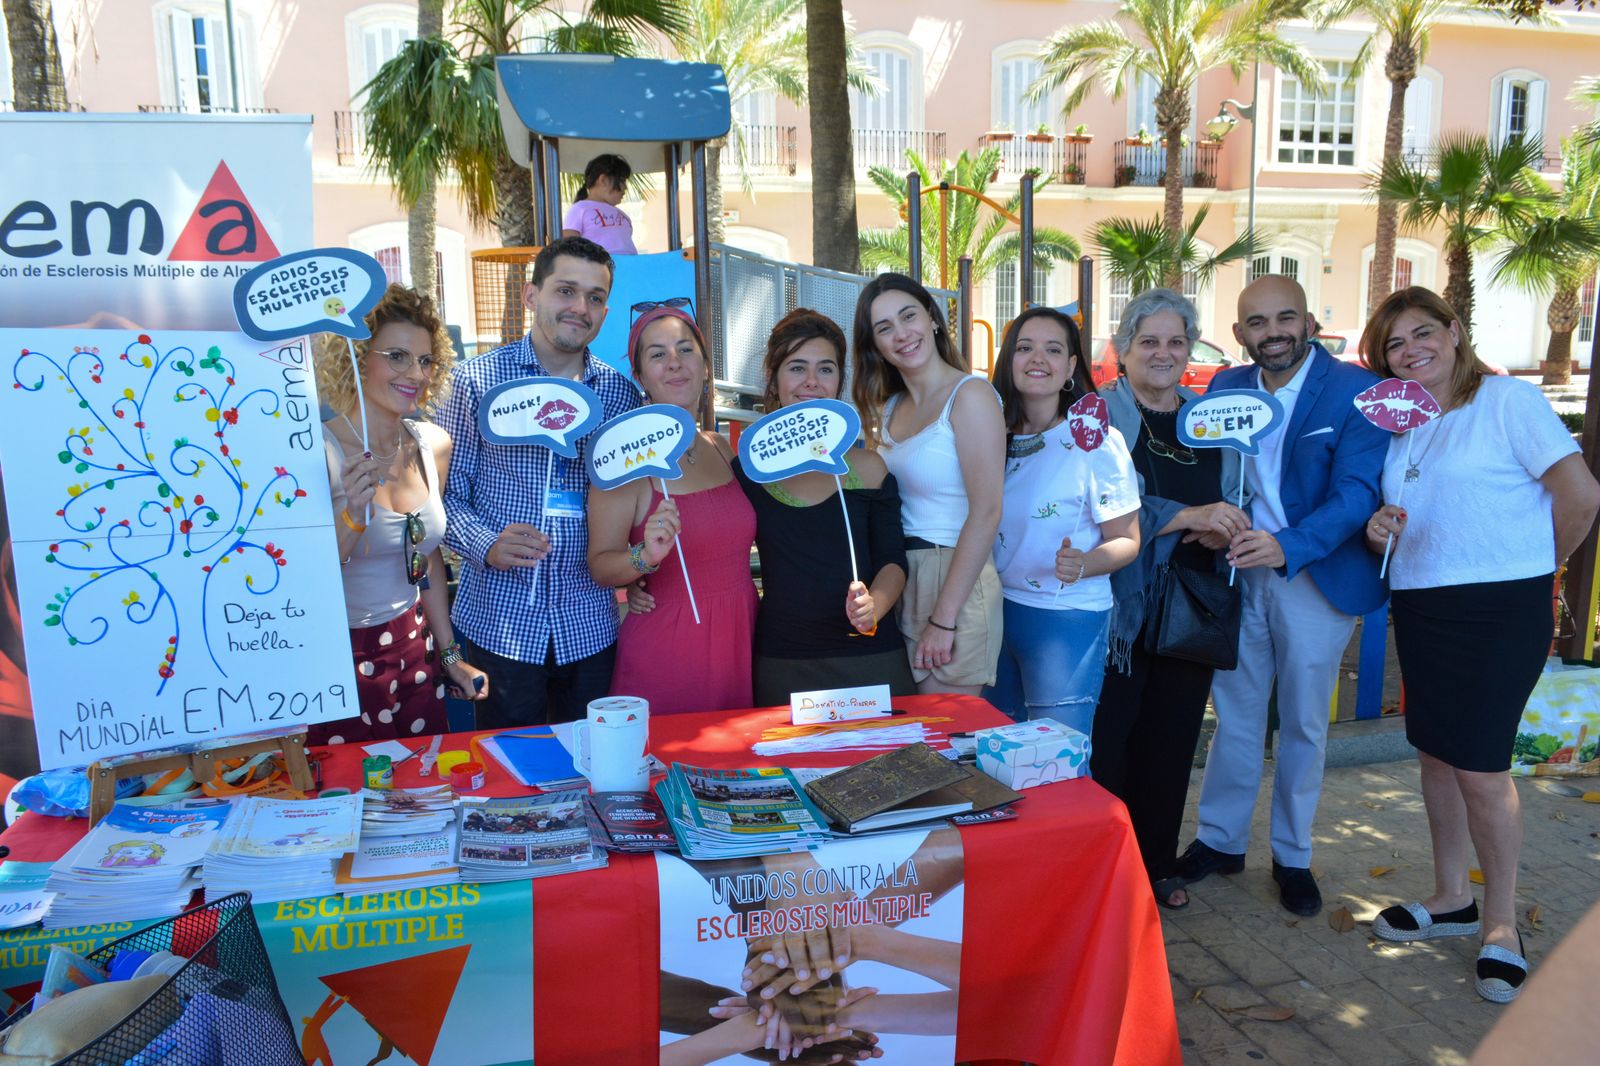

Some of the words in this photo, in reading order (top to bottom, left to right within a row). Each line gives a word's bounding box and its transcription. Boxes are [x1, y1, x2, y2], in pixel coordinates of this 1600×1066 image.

[22, 265, 42, 277] de
[46, 264, 129, 277] Esclerosis
[133, 264, 195, 280] Múltiple
[200, 265, 219, 278] de
[248, 266, 349, 306] ESCLEROSIS
[271, 261, 319, 285] ADIOS
[258, 280, 347, 316] MULTIPLE!
[492, 395, 541, 418] MUACK!
[1191, 409, 1209, 417] MAS
[1211, 406, 1243, 416] FUERTE
[1245, 404, 1263, 412] QUE
[1224, 414, 1254, 432] EM
[750, 414, 830, 453] ESCLEROSIS
[767, 412, 806, 436] ADIOS
[593, 449, 616, 469] HOY
[620, 422, 681, 455] MUERDO!
[759, 426, 828, 461] MULTIPLE!
[223, 602, 276, 629] Deja
[281, 598, 306, 619] tu
[227, 631, 304, 653] huella.
[709, 871, 797, 906] UNIDOS
[801, 862, 889, 895] CONTRA
[891, 858, 919, 888] LA
[274, 882, 481, 922] ESCLEROSIS
[696, 904, 828, 943] ESCLEROSIS
[832, 892, 933, 928] MÚLTIPLE
